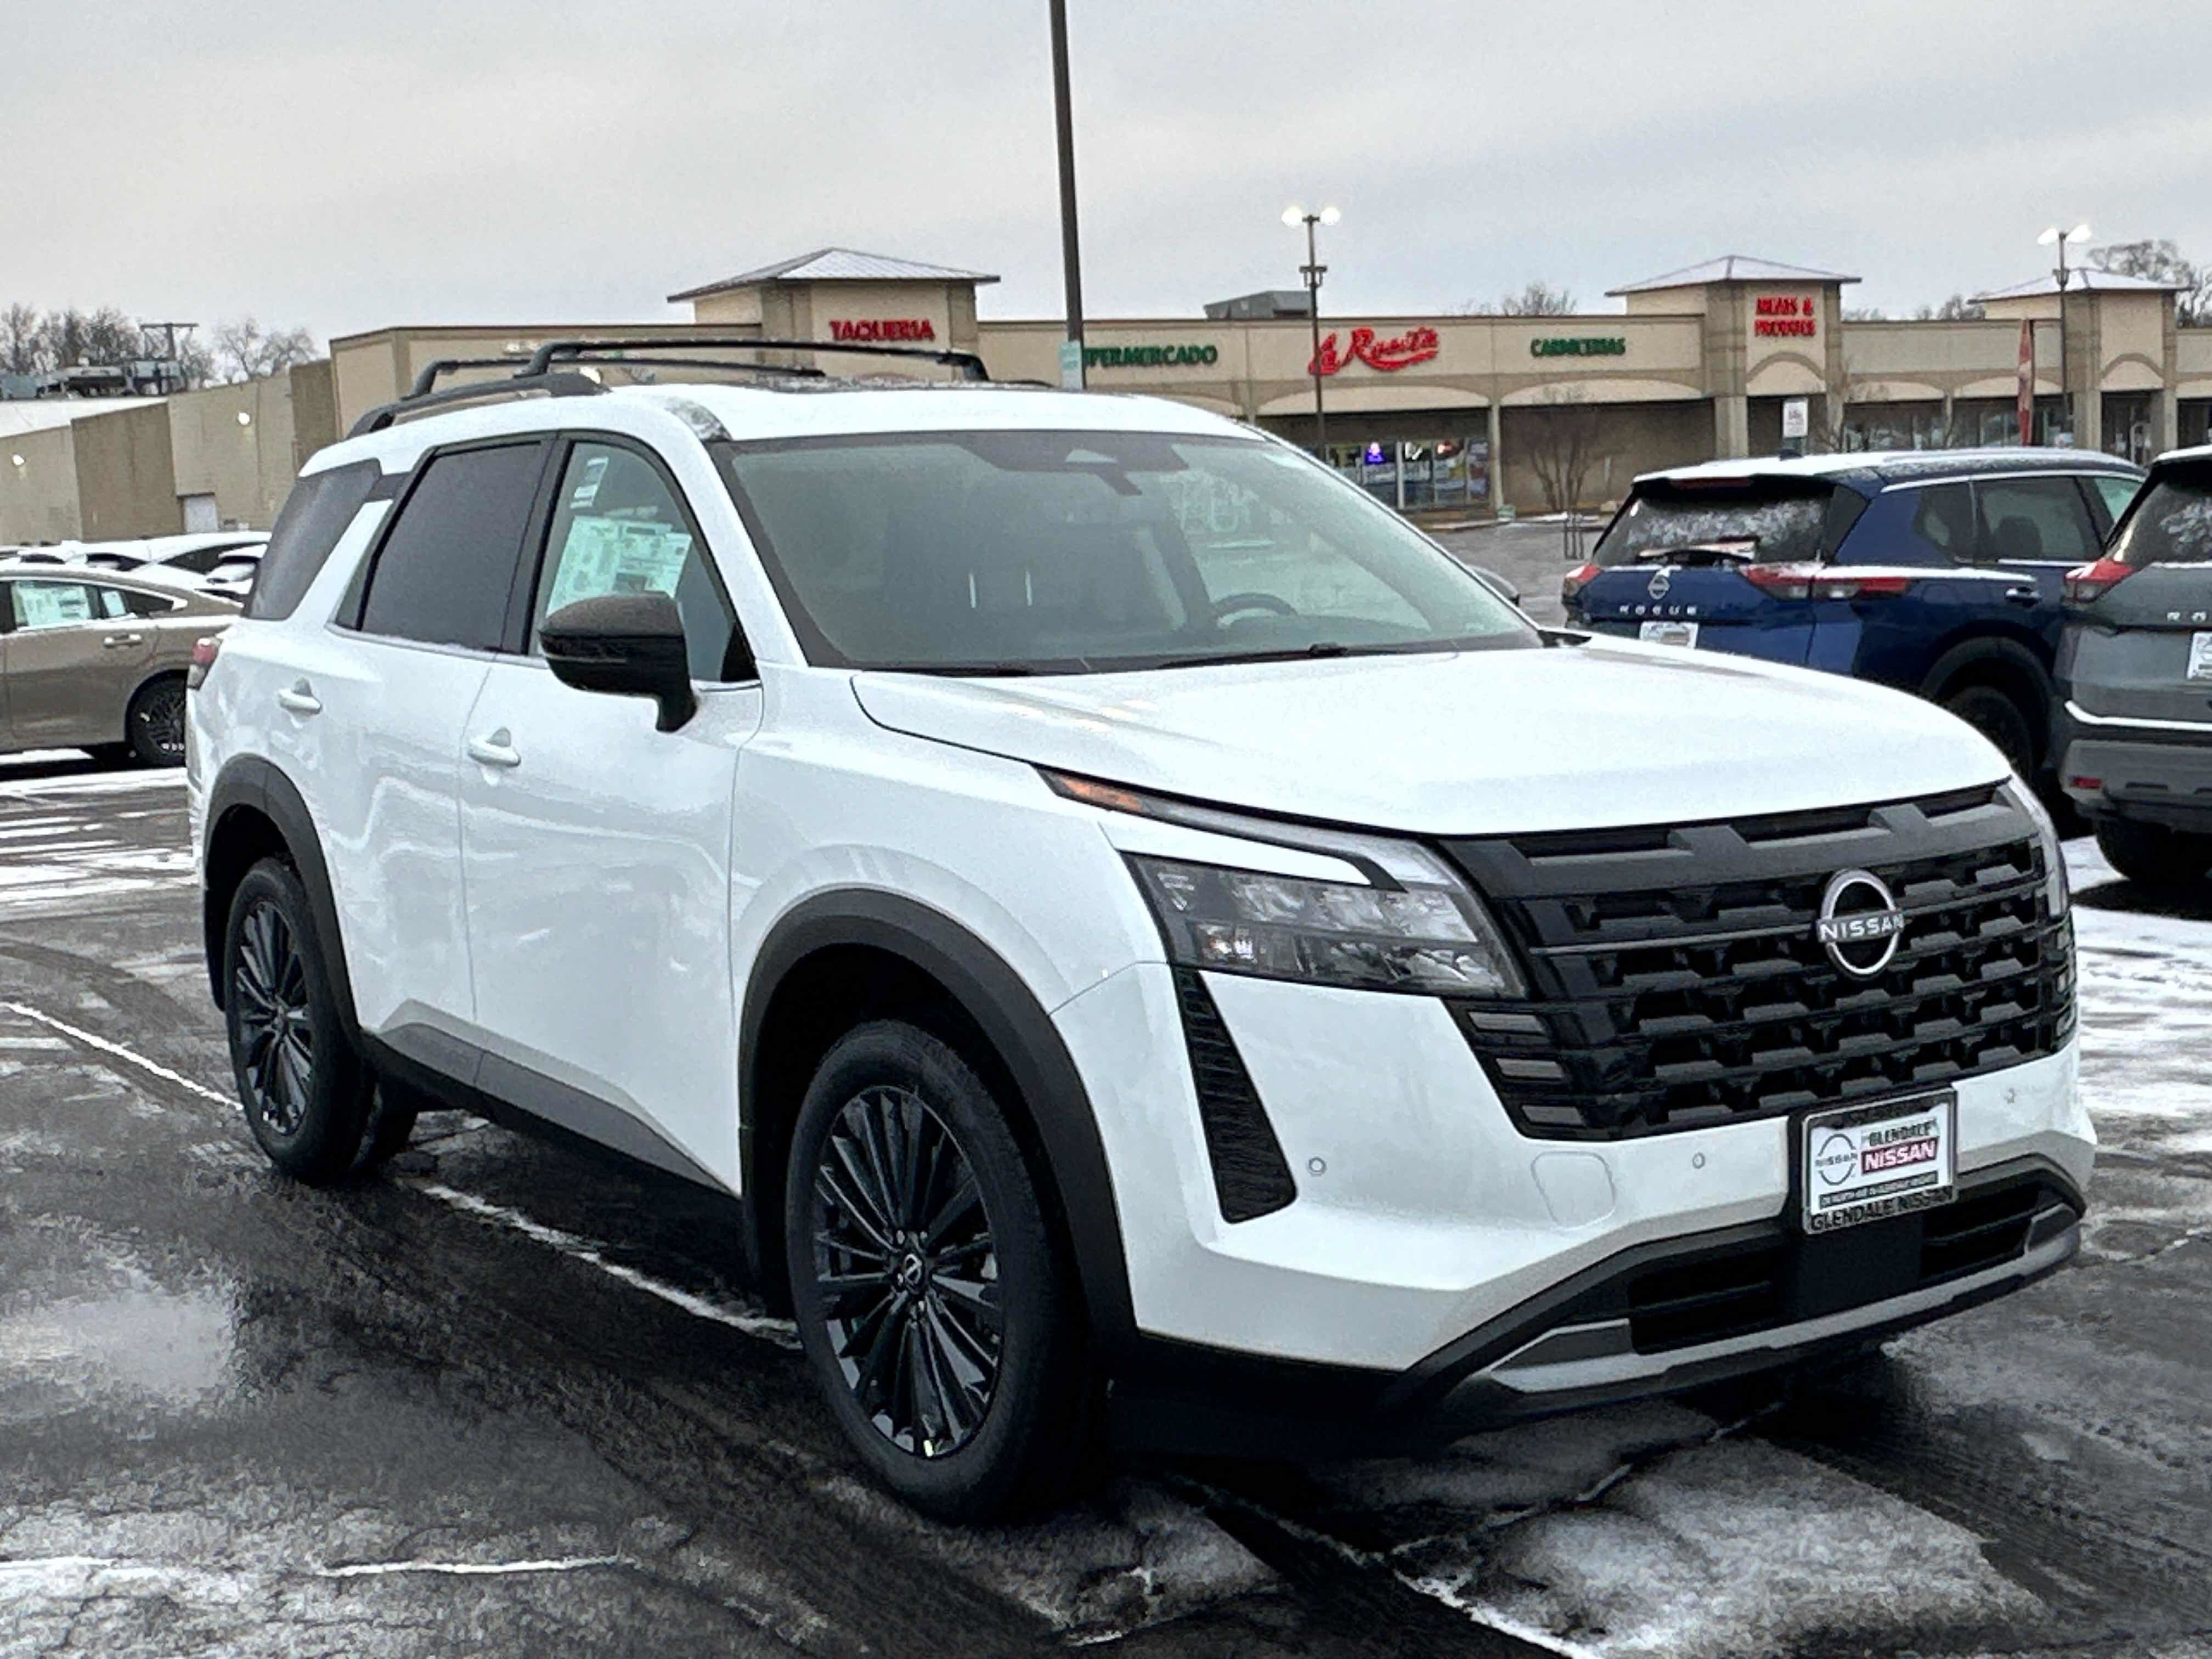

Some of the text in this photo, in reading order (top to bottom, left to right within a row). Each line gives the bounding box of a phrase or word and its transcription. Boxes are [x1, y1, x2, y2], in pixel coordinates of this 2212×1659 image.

[830, 319, 936, 341] TAQUERIA
[1819, 913, 1904, 940] NISSAN
[1815, 1153, 1858, 1167] NISSAN
[1865, 1141, 1936, 1171] NISSAN
[1811, 1198, 1893, 1231] GLENDALE
